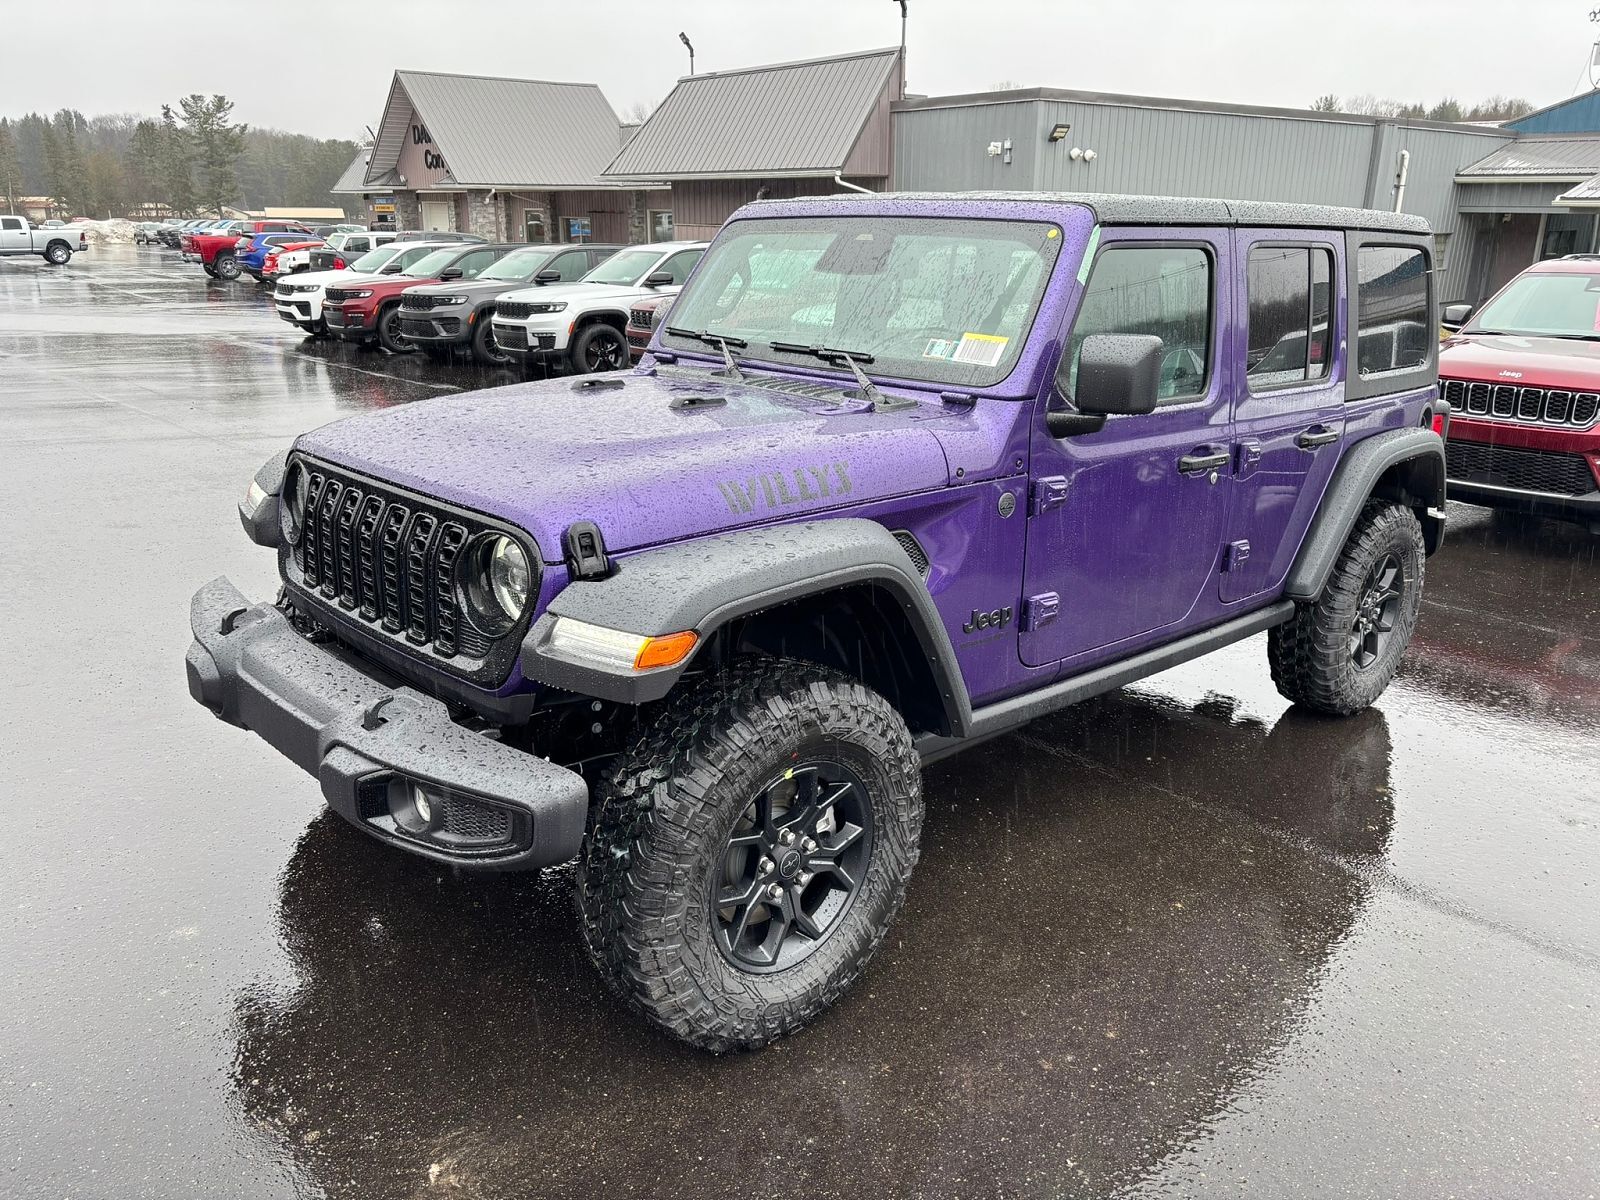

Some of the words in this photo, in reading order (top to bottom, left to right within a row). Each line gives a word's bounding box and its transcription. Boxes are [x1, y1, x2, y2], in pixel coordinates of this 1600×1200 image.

[1499, 369, 1523, 379] Jeep
[716, 460, 853, 515] WILLYS
[962, 606, 1013, 634] Jeep
